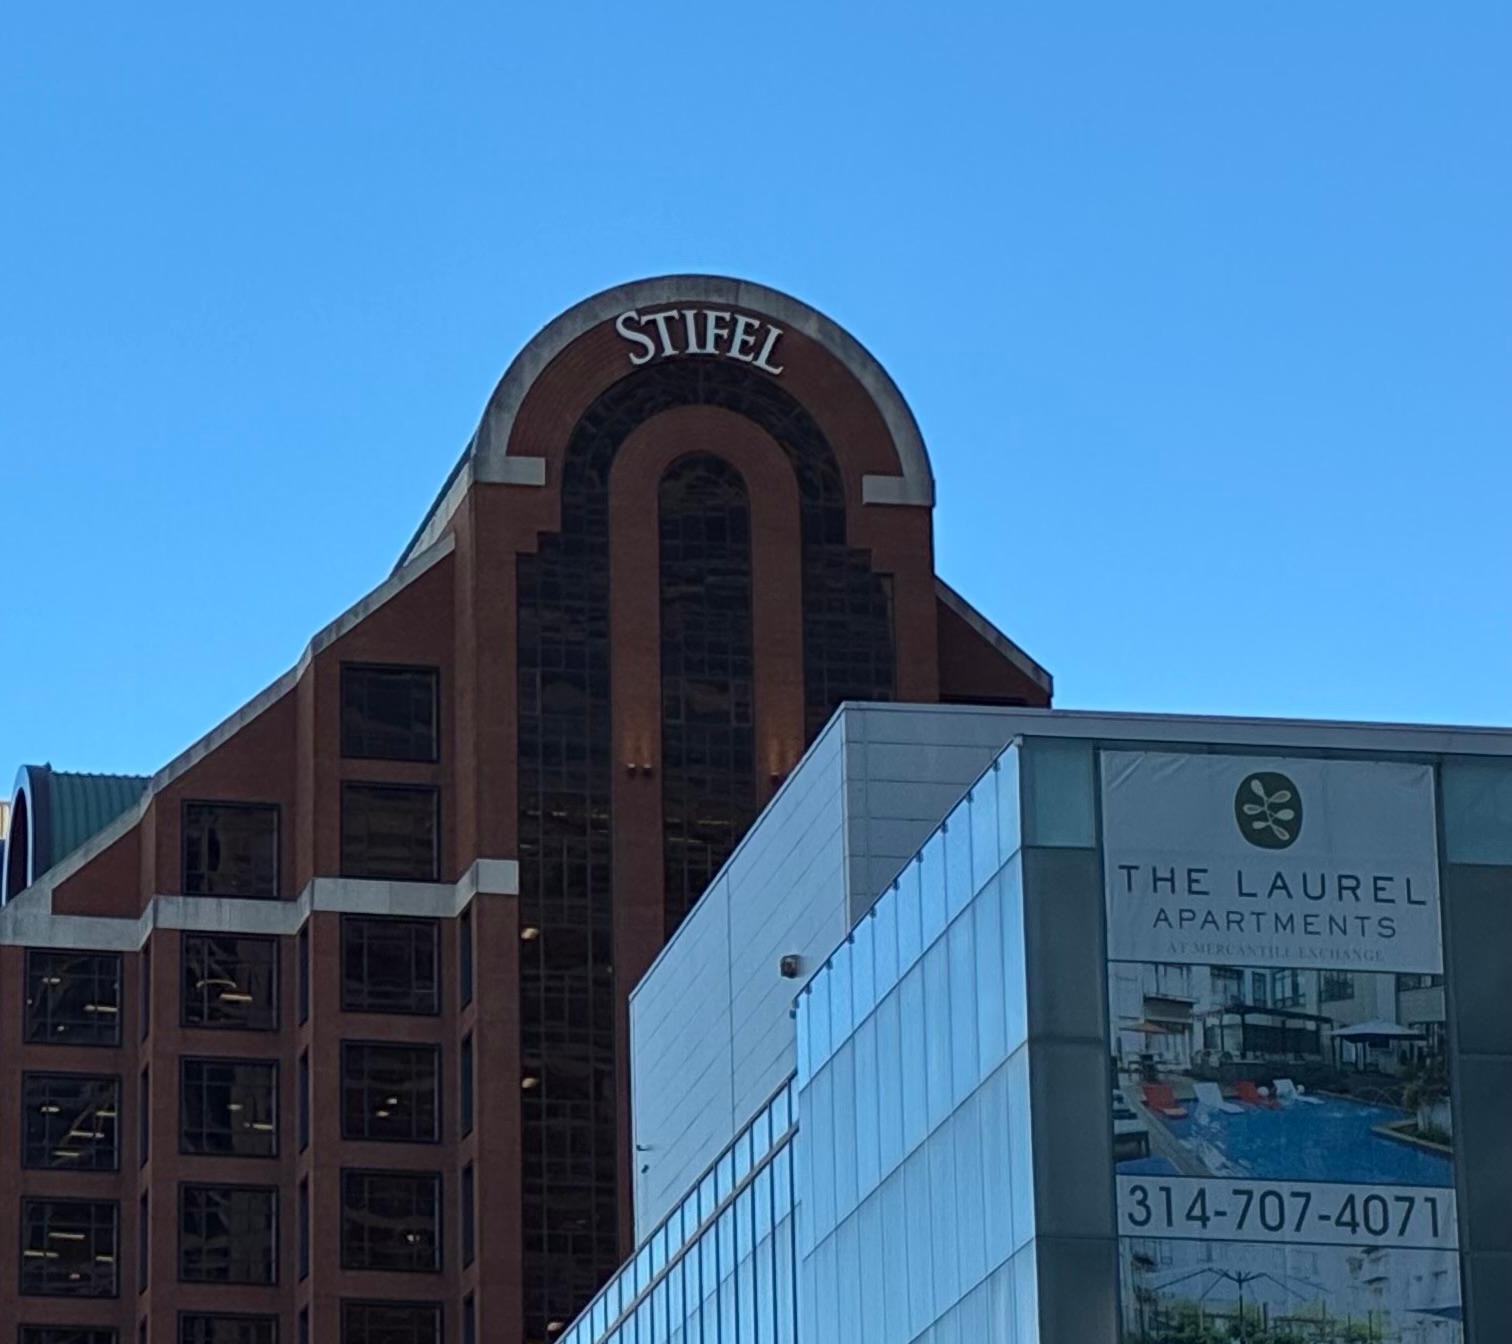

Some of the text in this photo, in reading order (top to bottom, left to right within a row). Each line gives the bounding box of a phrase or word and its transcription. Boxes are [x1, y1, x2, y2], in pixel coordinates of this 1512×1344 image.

[615, 309, 785, 376] STIFEL
[1118, 864, 1428, 906] THE LAUREL
[1152, 907, 1397, 939] APARTMENTS
[1167, 942, 1384, 962] AT MERCANTILE EXCHANGE
[1127, 1183, 1441, 1237] 314-707-4071
